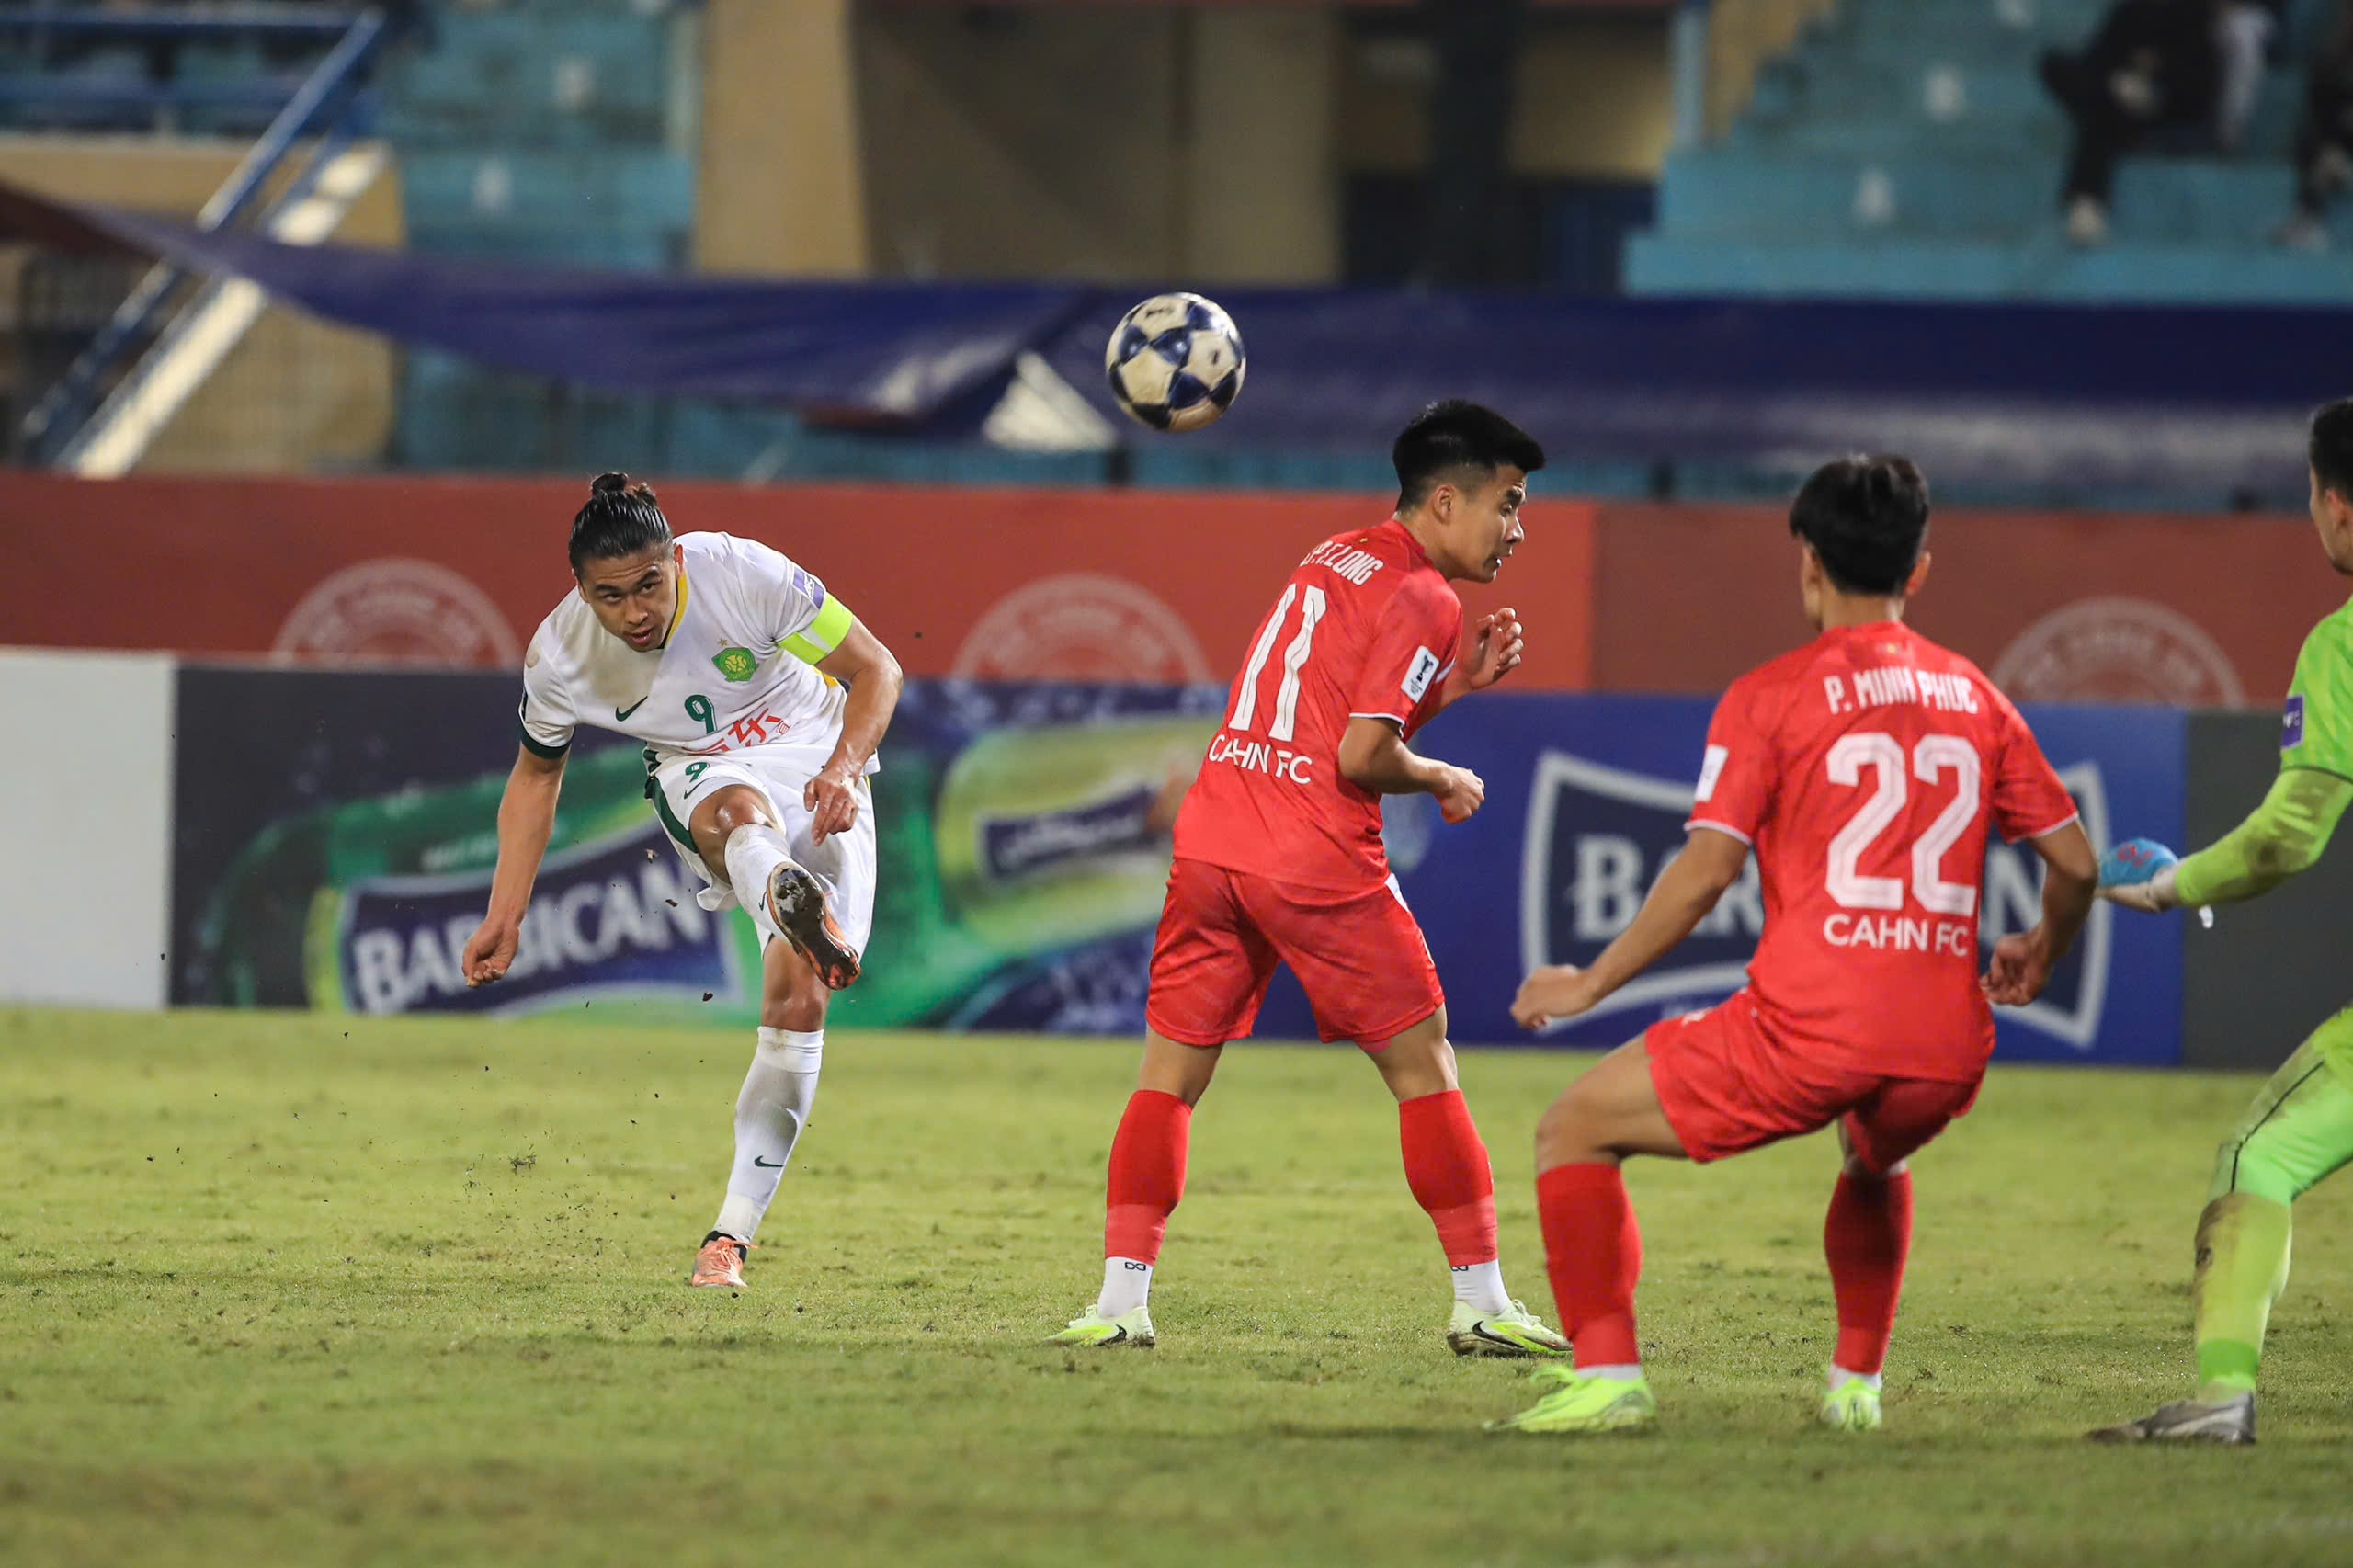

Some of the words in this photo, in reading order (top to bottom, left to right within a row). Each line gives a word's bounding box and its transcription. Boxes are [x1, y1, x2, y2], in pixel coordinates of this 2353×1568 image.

[1228, 583, 1327, 743] 11
[684, 694, 718, 735] 9
[1824, 676, 1853, 715] P.
[1852, 665, 1917, 710] MINH
[685, 761, 710, 783] 9
[1208, 733, 1271, 774] CAHN
[1275, 749, 1313, 785] FC
[1825, 732, 1981, 917] 22
[1823, 913, 1929, 952] CAHN
[1935, 922, 1970, 957] FC
